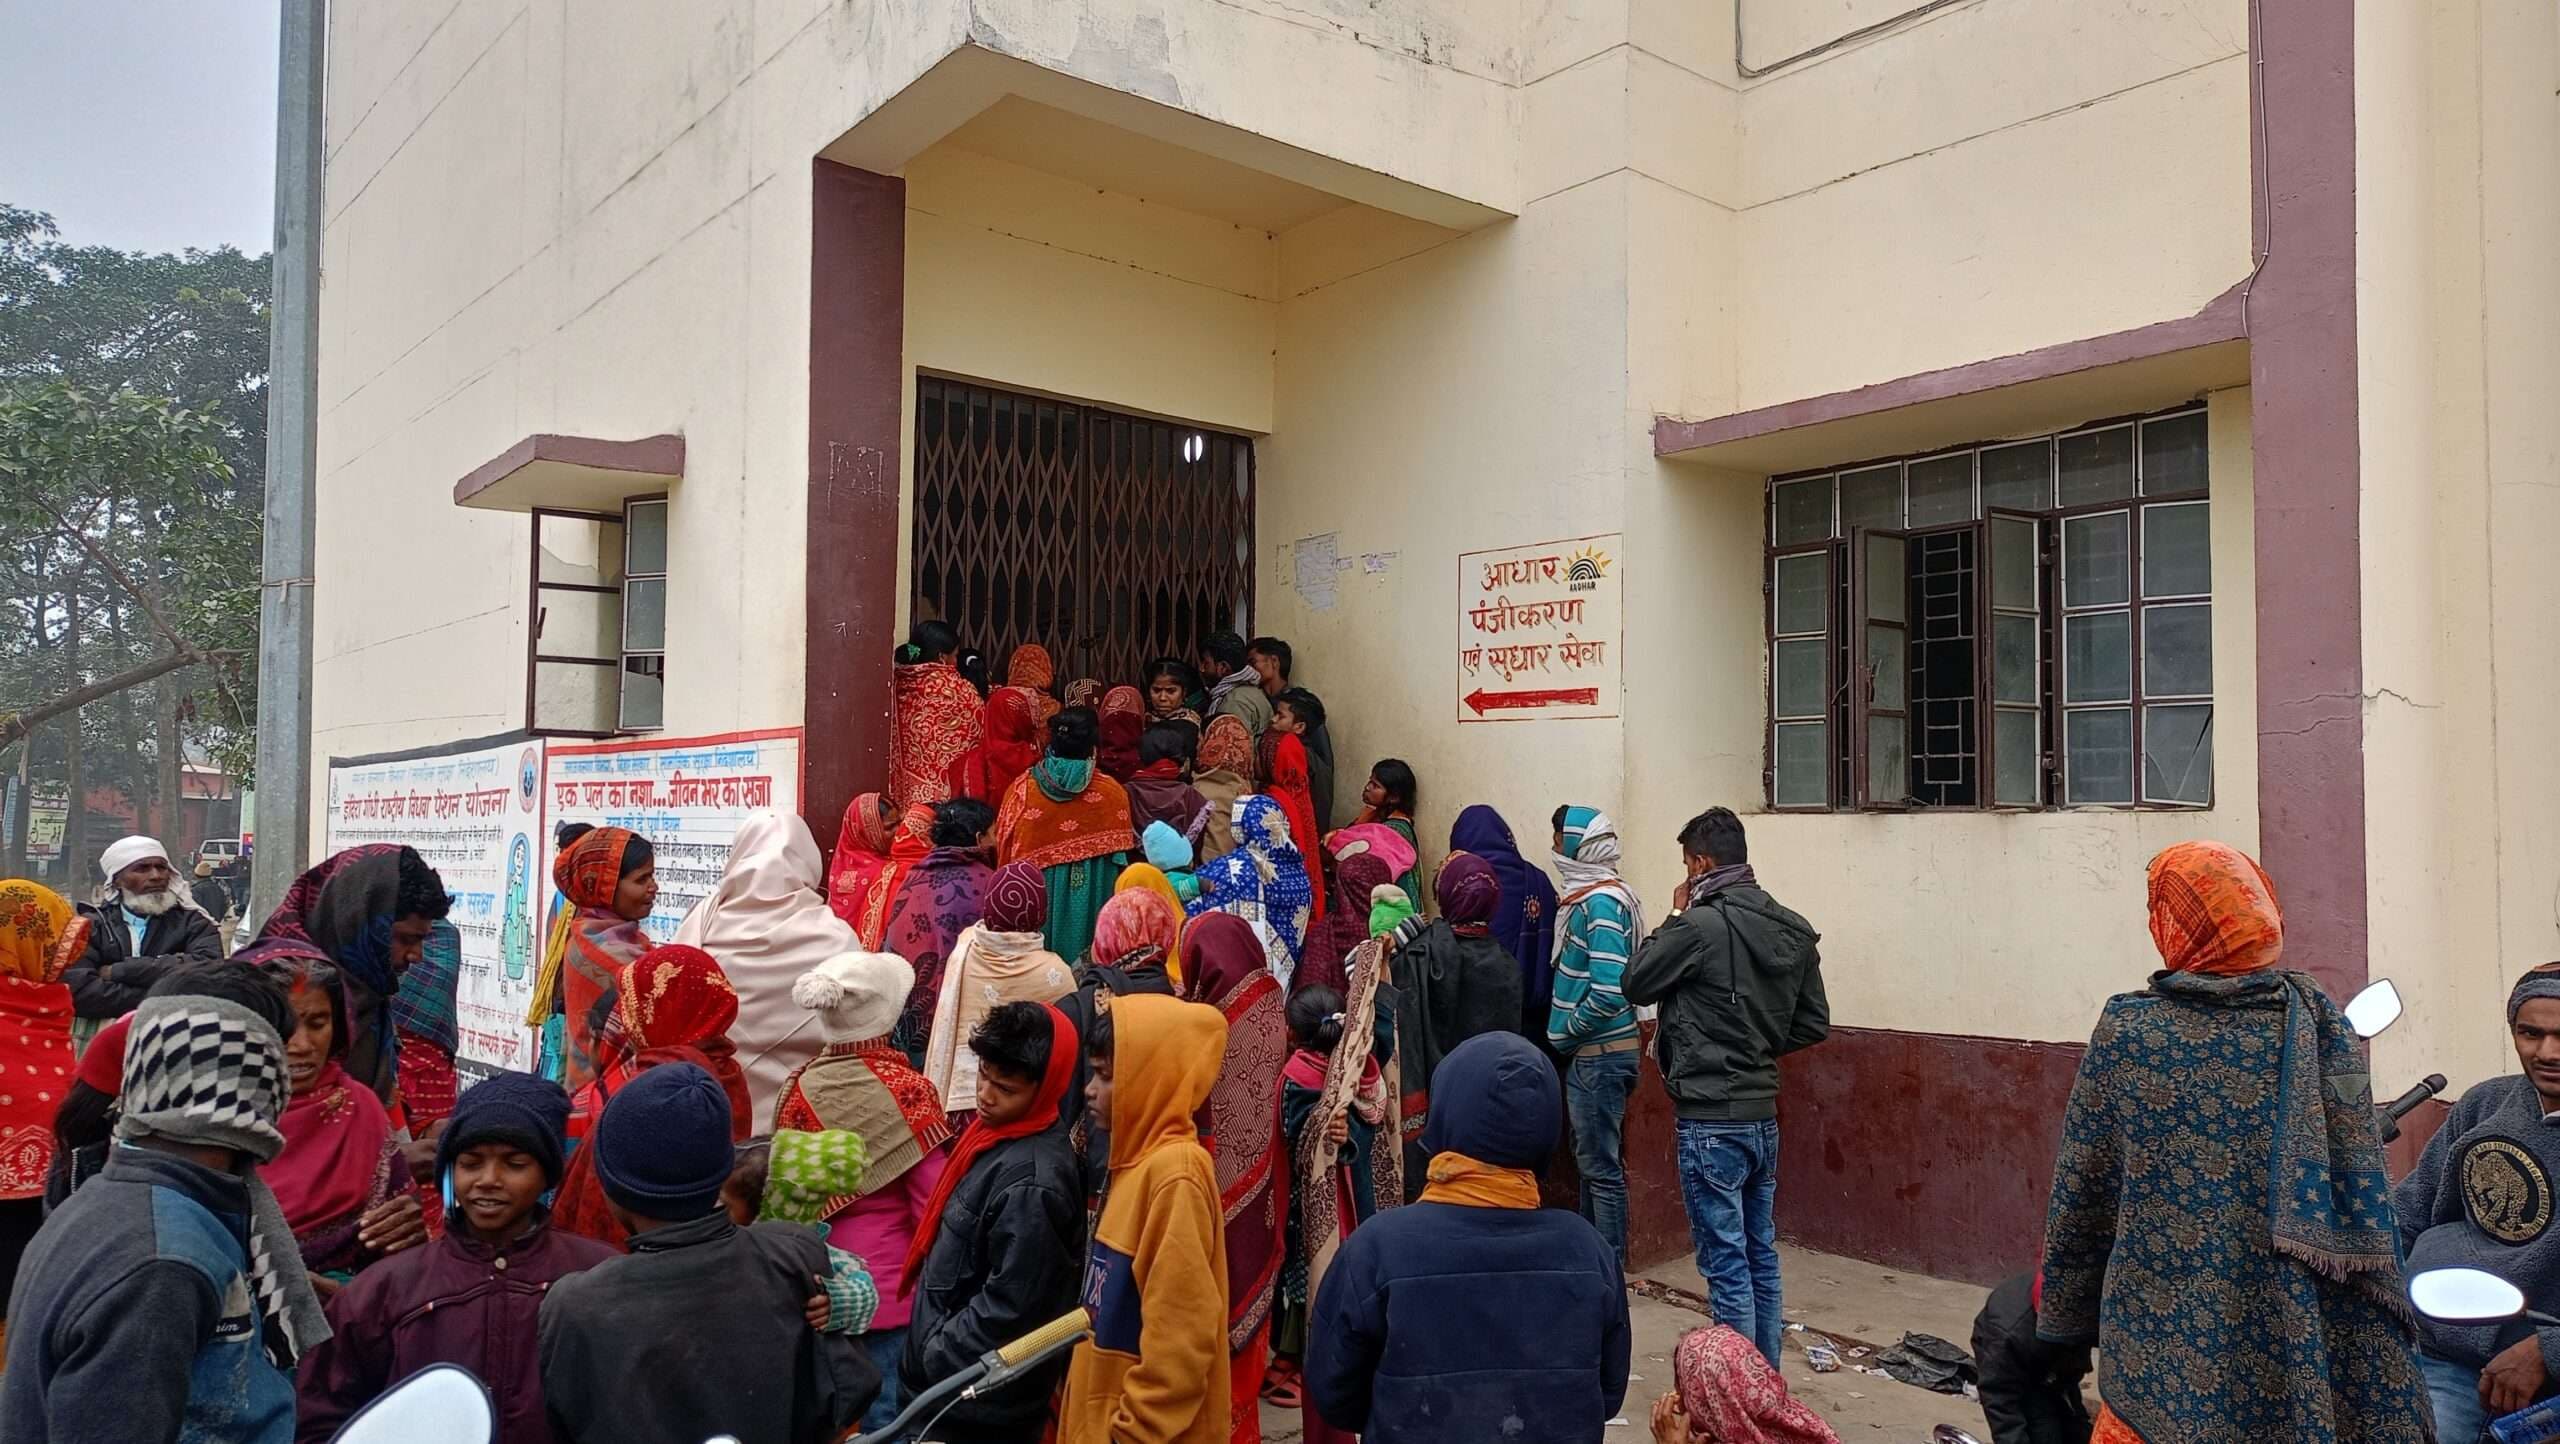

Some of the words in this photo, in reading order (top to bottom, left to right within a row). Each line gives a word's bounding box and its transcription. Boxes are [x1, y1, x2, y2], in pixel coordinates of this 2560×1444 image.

[1481, 556, 1561, 592] आधार
[1469, 596, 1585, 633] पंजीकरण
[1462, 643, 1483, 677] एवं
[1487, 644, 1552, 682] सुधार
[1558, 633, 1607, 671] सेवा
[466, 781, 510, 817] योजना
[555, 782, 578, 812] एक
[582, 782, 605, 811] पल
[608, 781, 627, 809] का
[701, 778, 720, 810] भर
[722, 777, 740, 808] का
